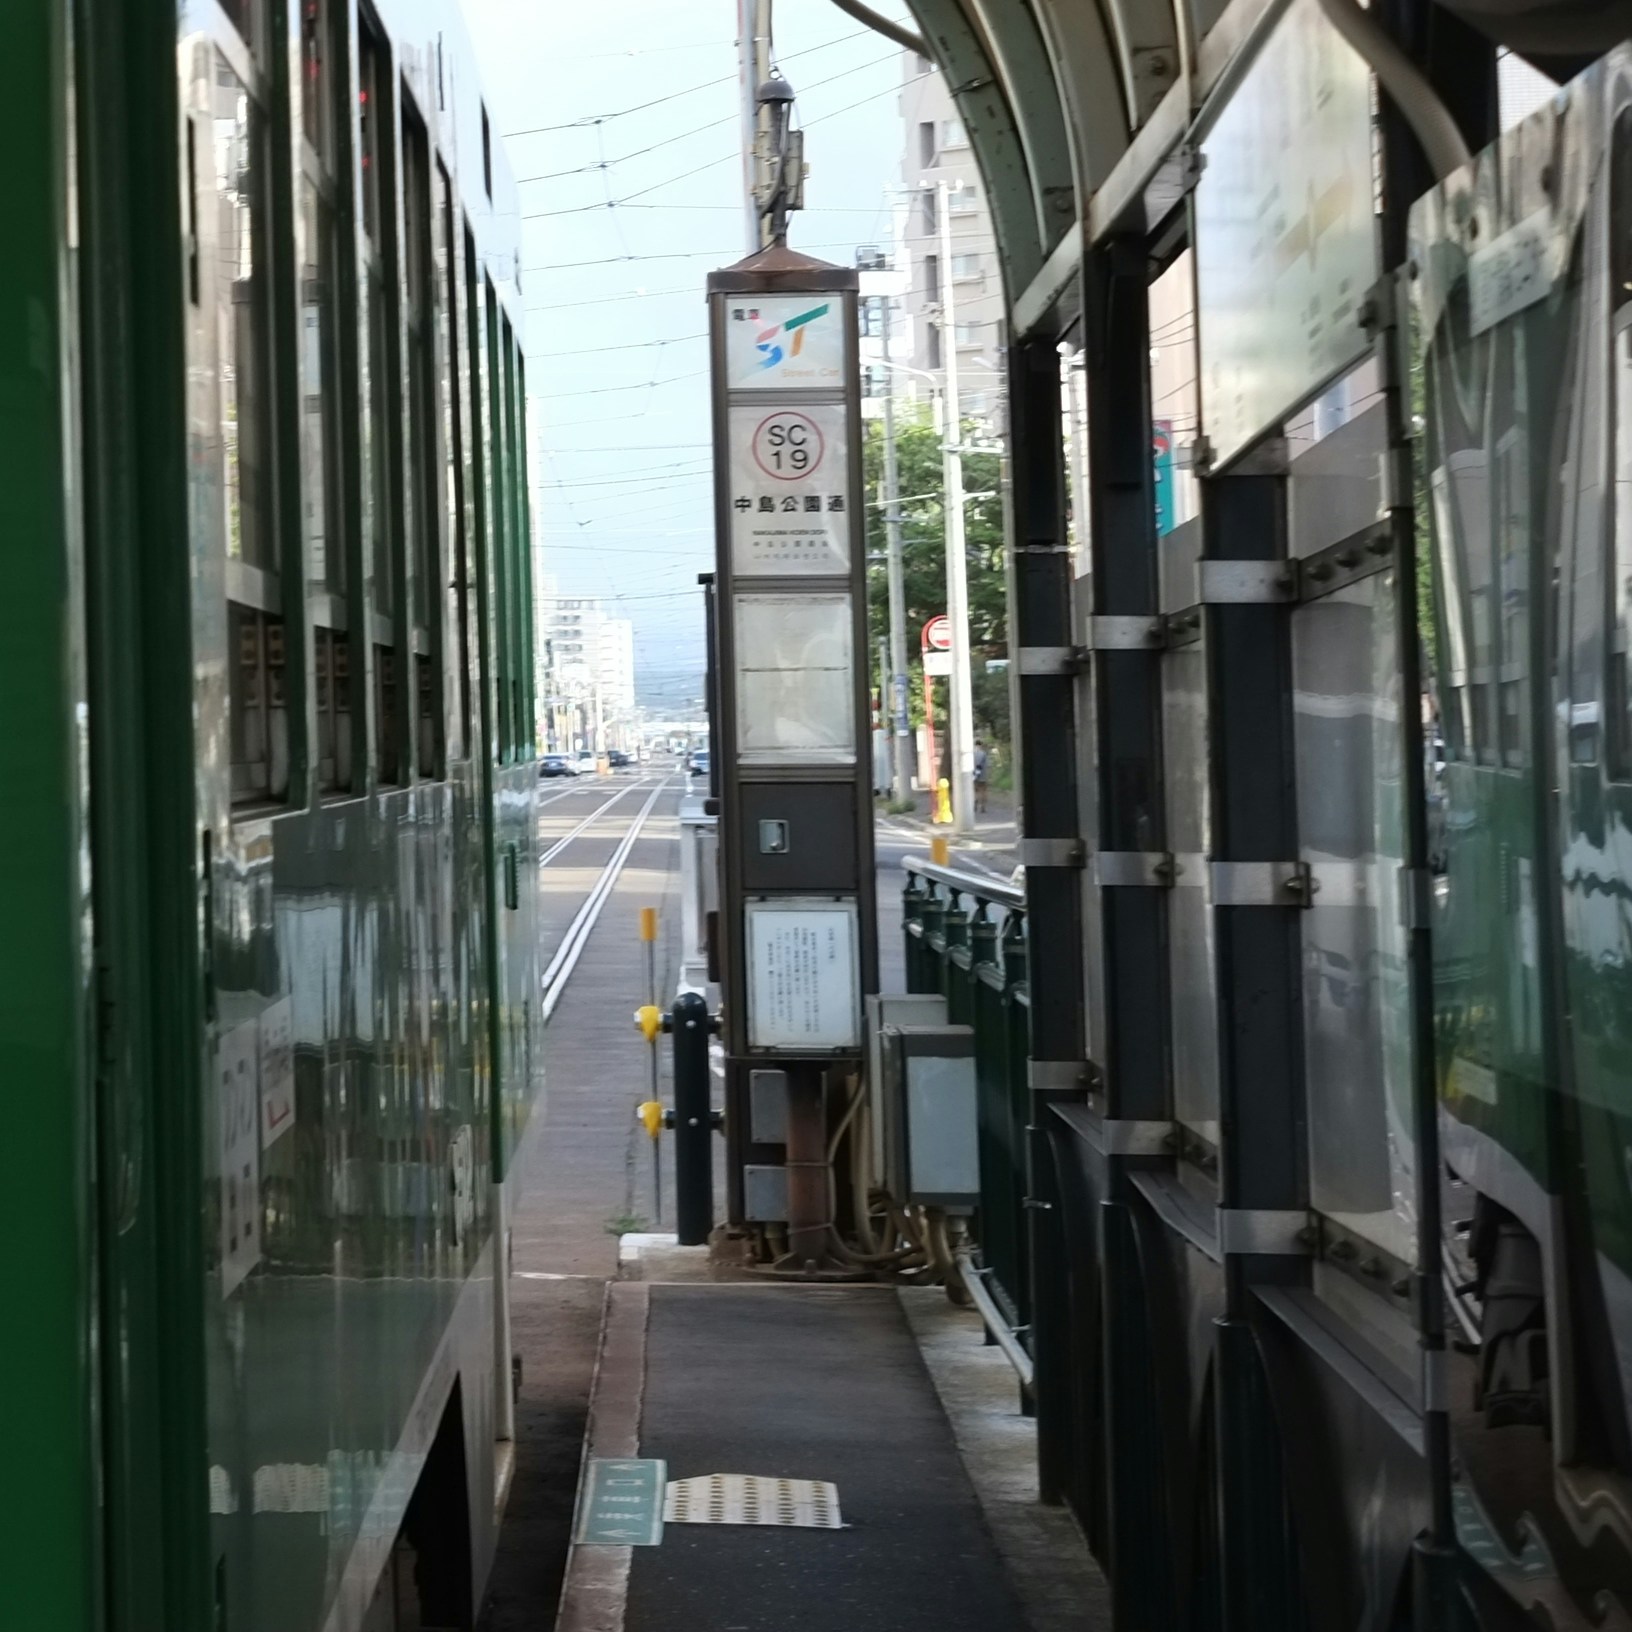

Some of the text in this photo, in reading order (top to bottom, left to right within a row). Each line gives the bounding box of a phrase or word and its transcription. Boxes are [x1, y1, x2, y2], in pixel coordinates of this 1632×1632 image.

[767, 424, 807, 447] SC
[771, 449, 809, 470] 19
[734, 494, 846, 514] 中島公園通
